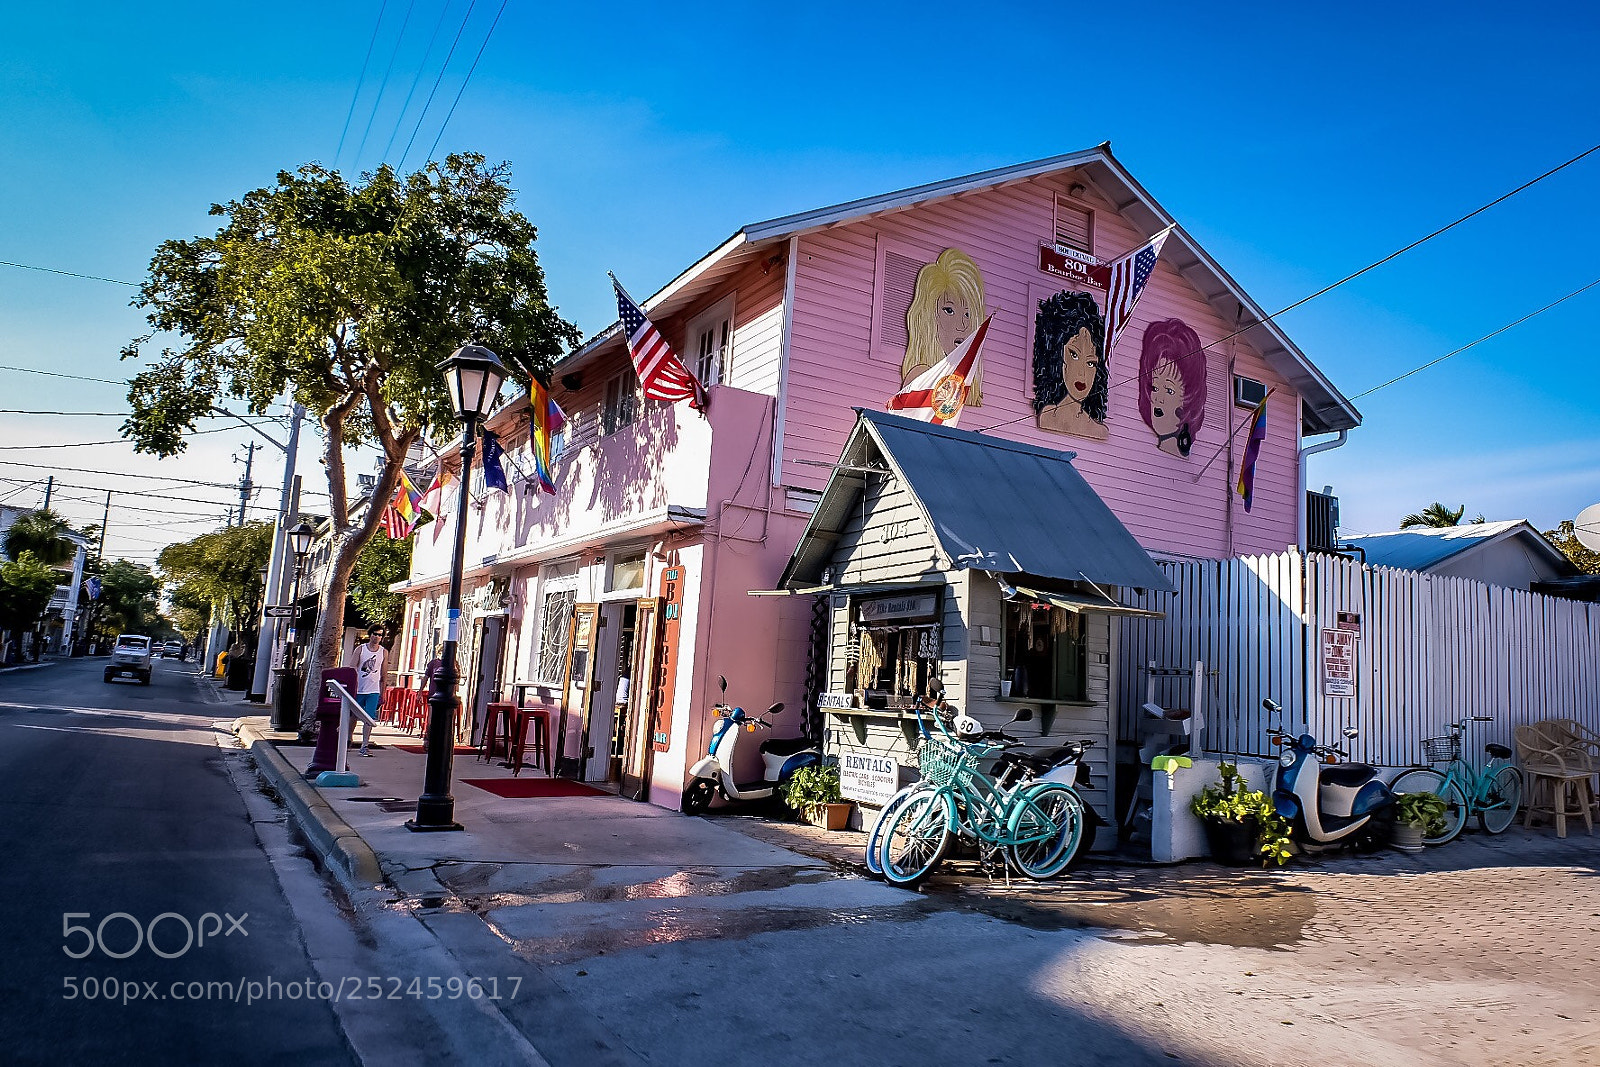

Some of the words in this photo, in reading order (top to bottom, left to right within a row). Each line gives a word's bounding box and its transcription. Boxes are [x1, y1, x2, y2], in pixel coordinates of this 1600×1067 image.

[1047, 263, 1086, 282] Bourbo
[1087, 276, 1103, 287] Bar
[1064, 258, 1088, 275] 801
[817, 694, 850, 707] RENTALS
[960, 719, 974, 733] 60
[845, 755, 892, 774] RENTALS
